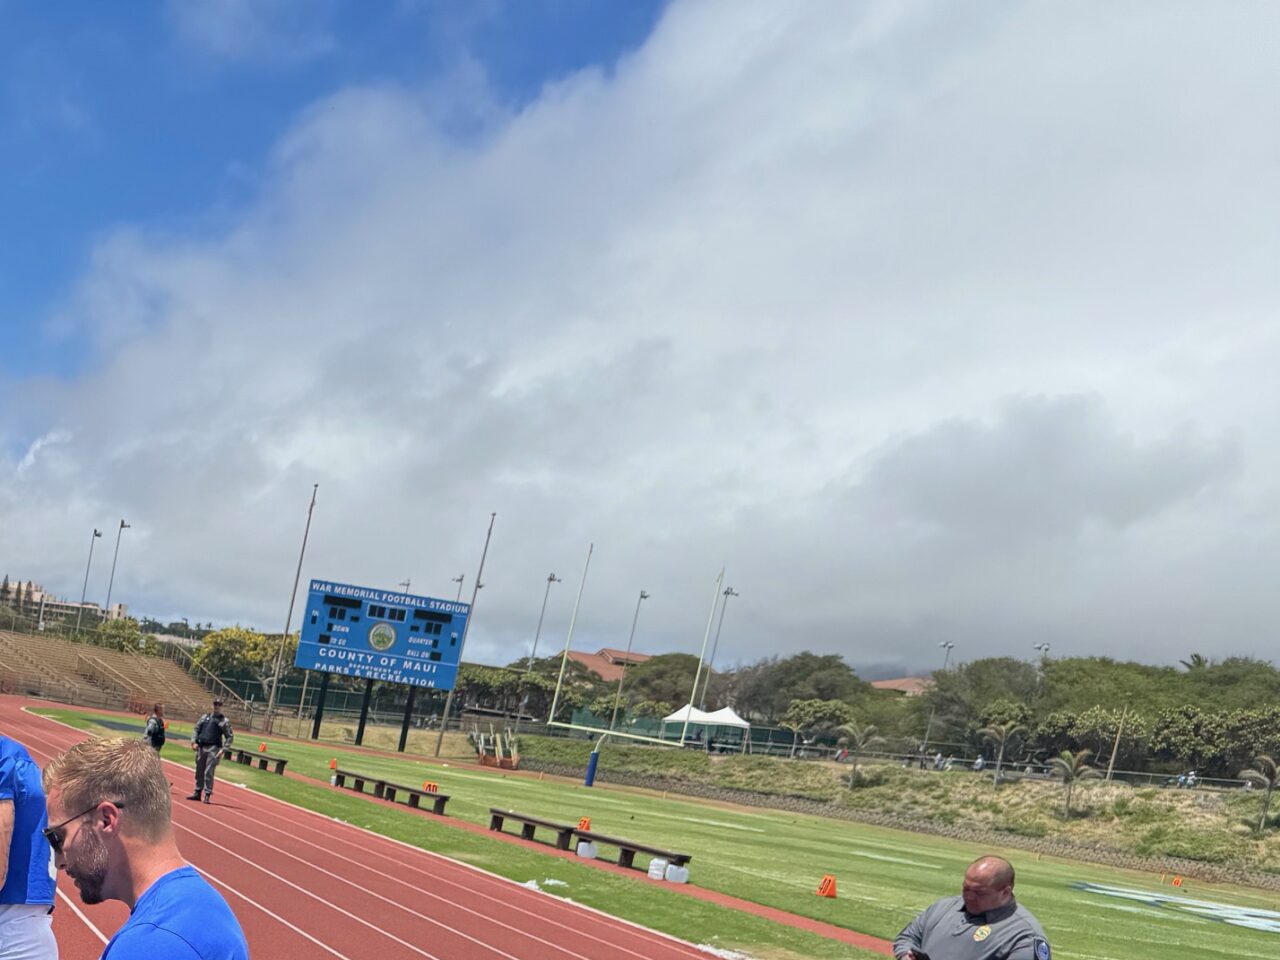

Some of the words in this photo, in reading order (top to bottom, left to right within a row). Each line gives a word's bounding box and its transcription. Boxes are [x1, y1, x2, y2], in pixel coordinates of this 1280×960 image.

[312, 582, 332, 593] WAR
[334, 586, 380, 600] MEMORIAL
[382, 593, 426, 608] FOOTBALL
[429, 601, 468, 614] STADIUM
[408, 636, 433, 646] QUARTER
[319, 648, 374, 664] COUNTY
[380, 657, 397, 667] OF
[403, 660, 437, 673] MAUI
[348, 662, 391, 674] DEPARTMENT
[314, 662, 350, 675] PARKS
[366, 671, 435, 688] RECREATION
